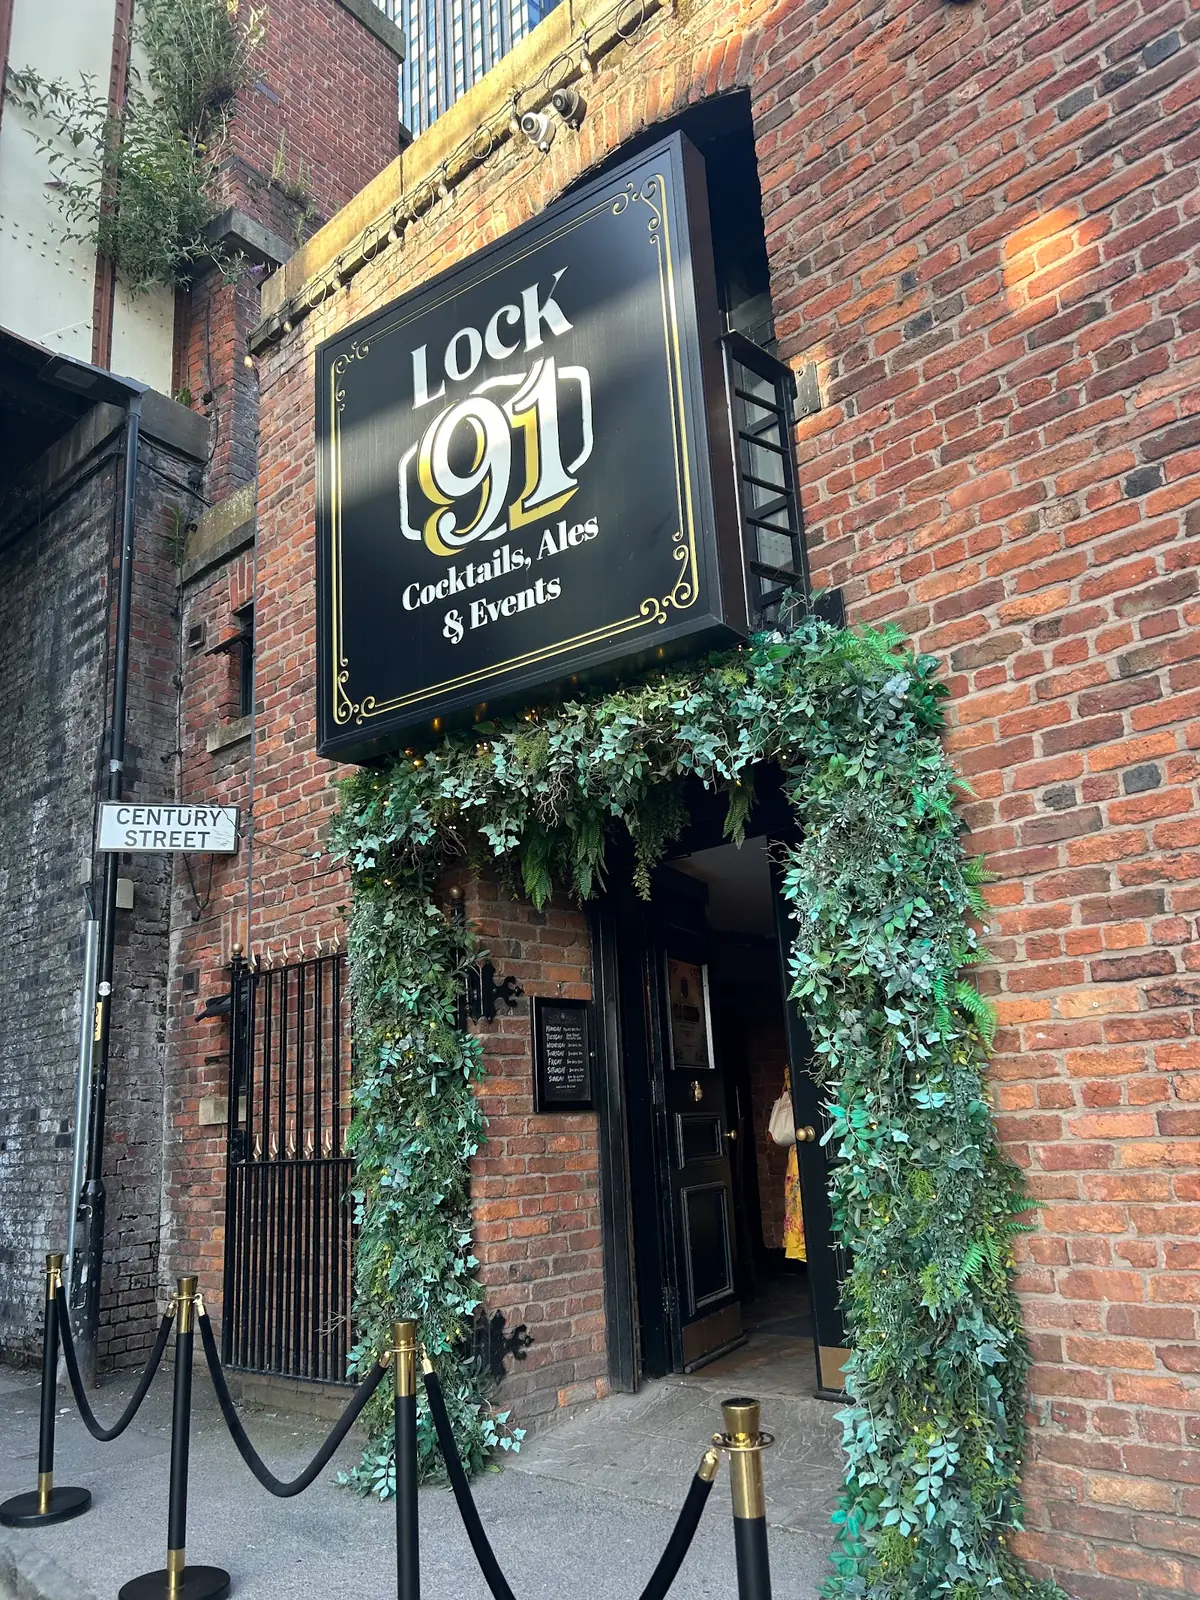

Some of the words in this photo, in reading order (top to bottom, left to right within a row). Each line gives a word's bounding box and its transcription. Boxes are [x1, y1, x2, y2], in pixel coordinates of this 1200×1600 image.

[410, 266, 573, 410] LOCK
[418, 355, 579, 556] 91
[402, 543, 531, 611] Cocktails,
[536, 516, 599, 560] Ales
[442, 609, 465, 645] &
[469, 576, 562, 630] Events
[116, 808, 222, 827] CENTURY
[124, 829, 211, 848] STREET
